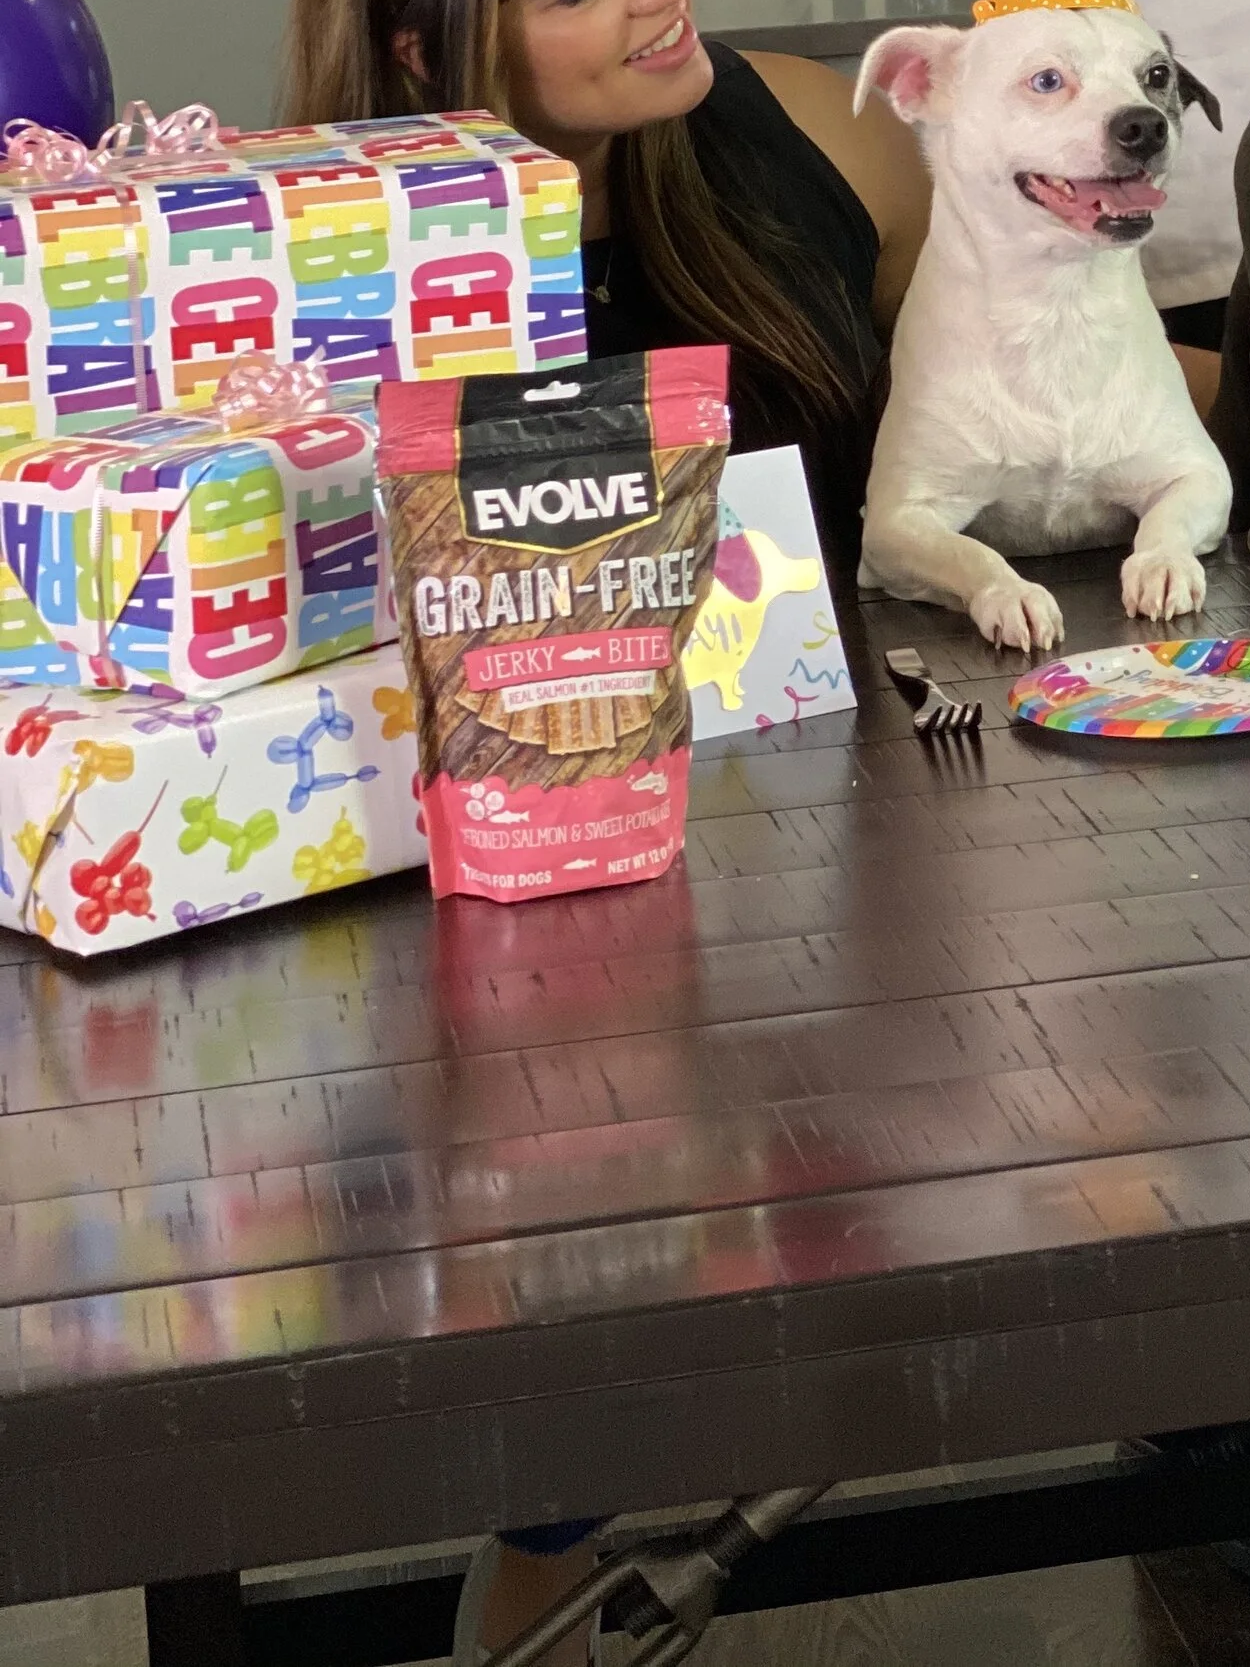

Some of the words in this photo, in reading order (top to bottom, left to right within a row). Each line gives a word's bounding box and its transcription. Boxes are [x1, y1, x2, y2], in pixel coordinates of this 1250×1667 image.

[473, 472, 649, 530] EVOLVE
[415, 548, 697, 637] GRAIN-FREE
[479, 645, 555, 682] JERKY
[508, 691, 534, 706] REAL
[536, 683, 577, 700] SALMON
[580, 681, 595, 694] #1
[598, 675, 651, 692] INGREDIENT
[460, 828, 510, 850] EBONED
[512, 825, 568, 849] SALMON
[571, 824, 582, 842] &
[584, 816, 623, 841] SWEET
[492, 874, 515, 888] FOR
[518, 870, 552, 887] DOGS
[608, 858, 630, 875] NET
[632, 853, 646, 869] WT
[648, 849, 660, 864] 12
